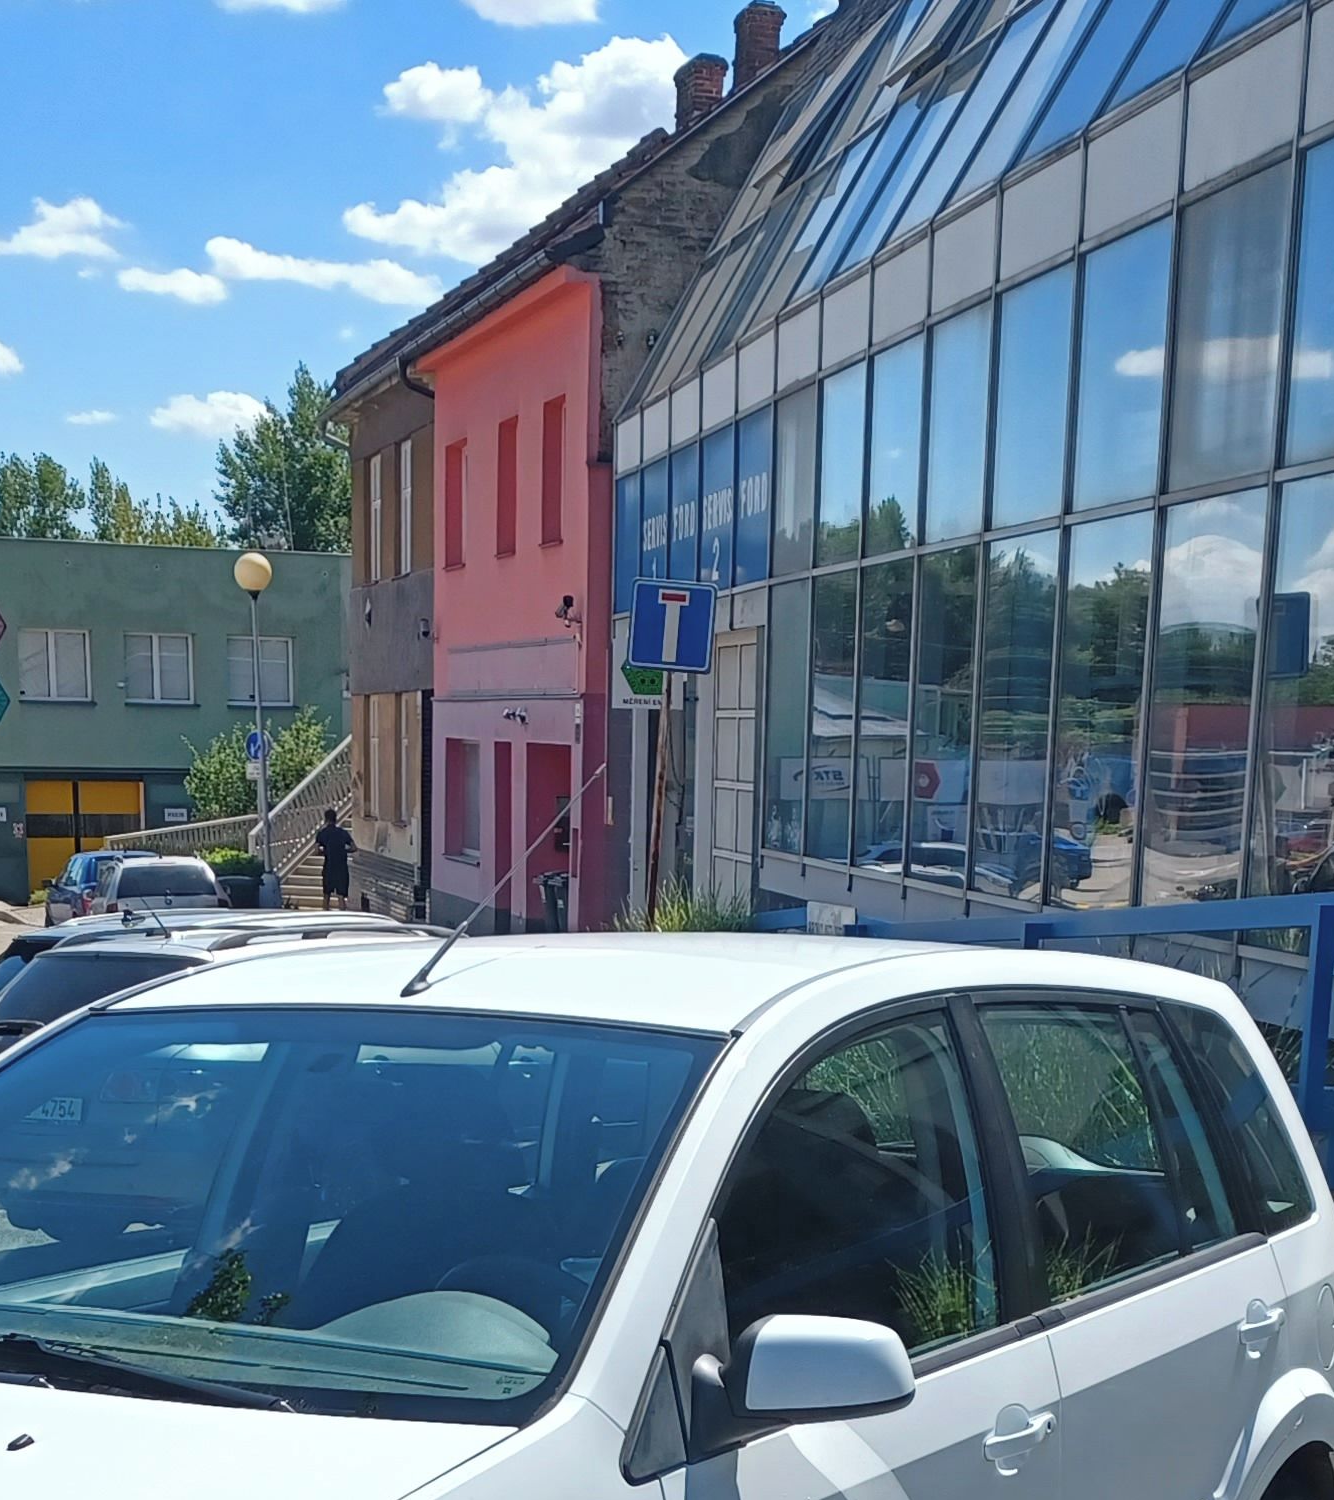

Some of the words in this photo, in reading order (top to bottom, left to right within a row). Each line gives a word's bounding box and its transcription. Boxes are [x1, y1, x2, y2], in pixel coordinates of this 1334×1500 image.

[643, 512, 667, 552] SERVIS
[673, 501, 696, 543] FORD
[703, 487, 733, 532] SERVIS
[740, 472, 768, 519] FORD
[711, 537, 721, 581] 2
